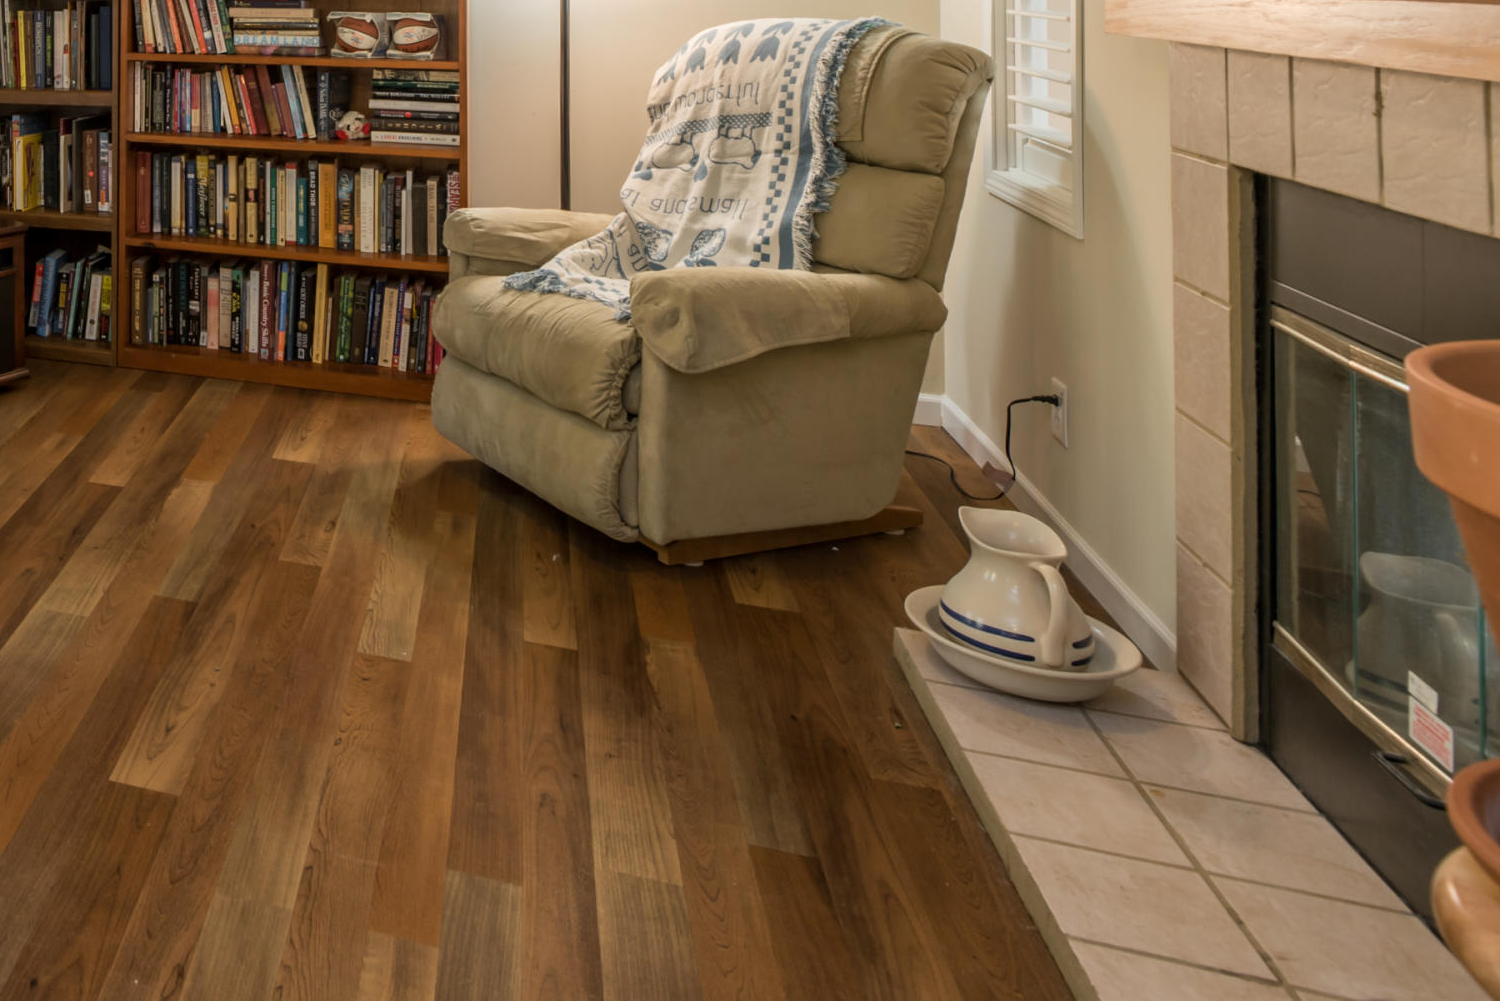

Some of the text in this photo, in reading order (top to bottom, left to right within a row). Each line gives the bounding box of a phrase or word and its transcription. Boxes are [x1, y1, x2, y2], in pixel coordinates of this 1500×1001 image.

[198, 177, 208, 217] Mayflower
[309, 189, 317, 207] THOR
[449, 181, 461, 214] SEARC
[261, 299, 269, 327] Country
